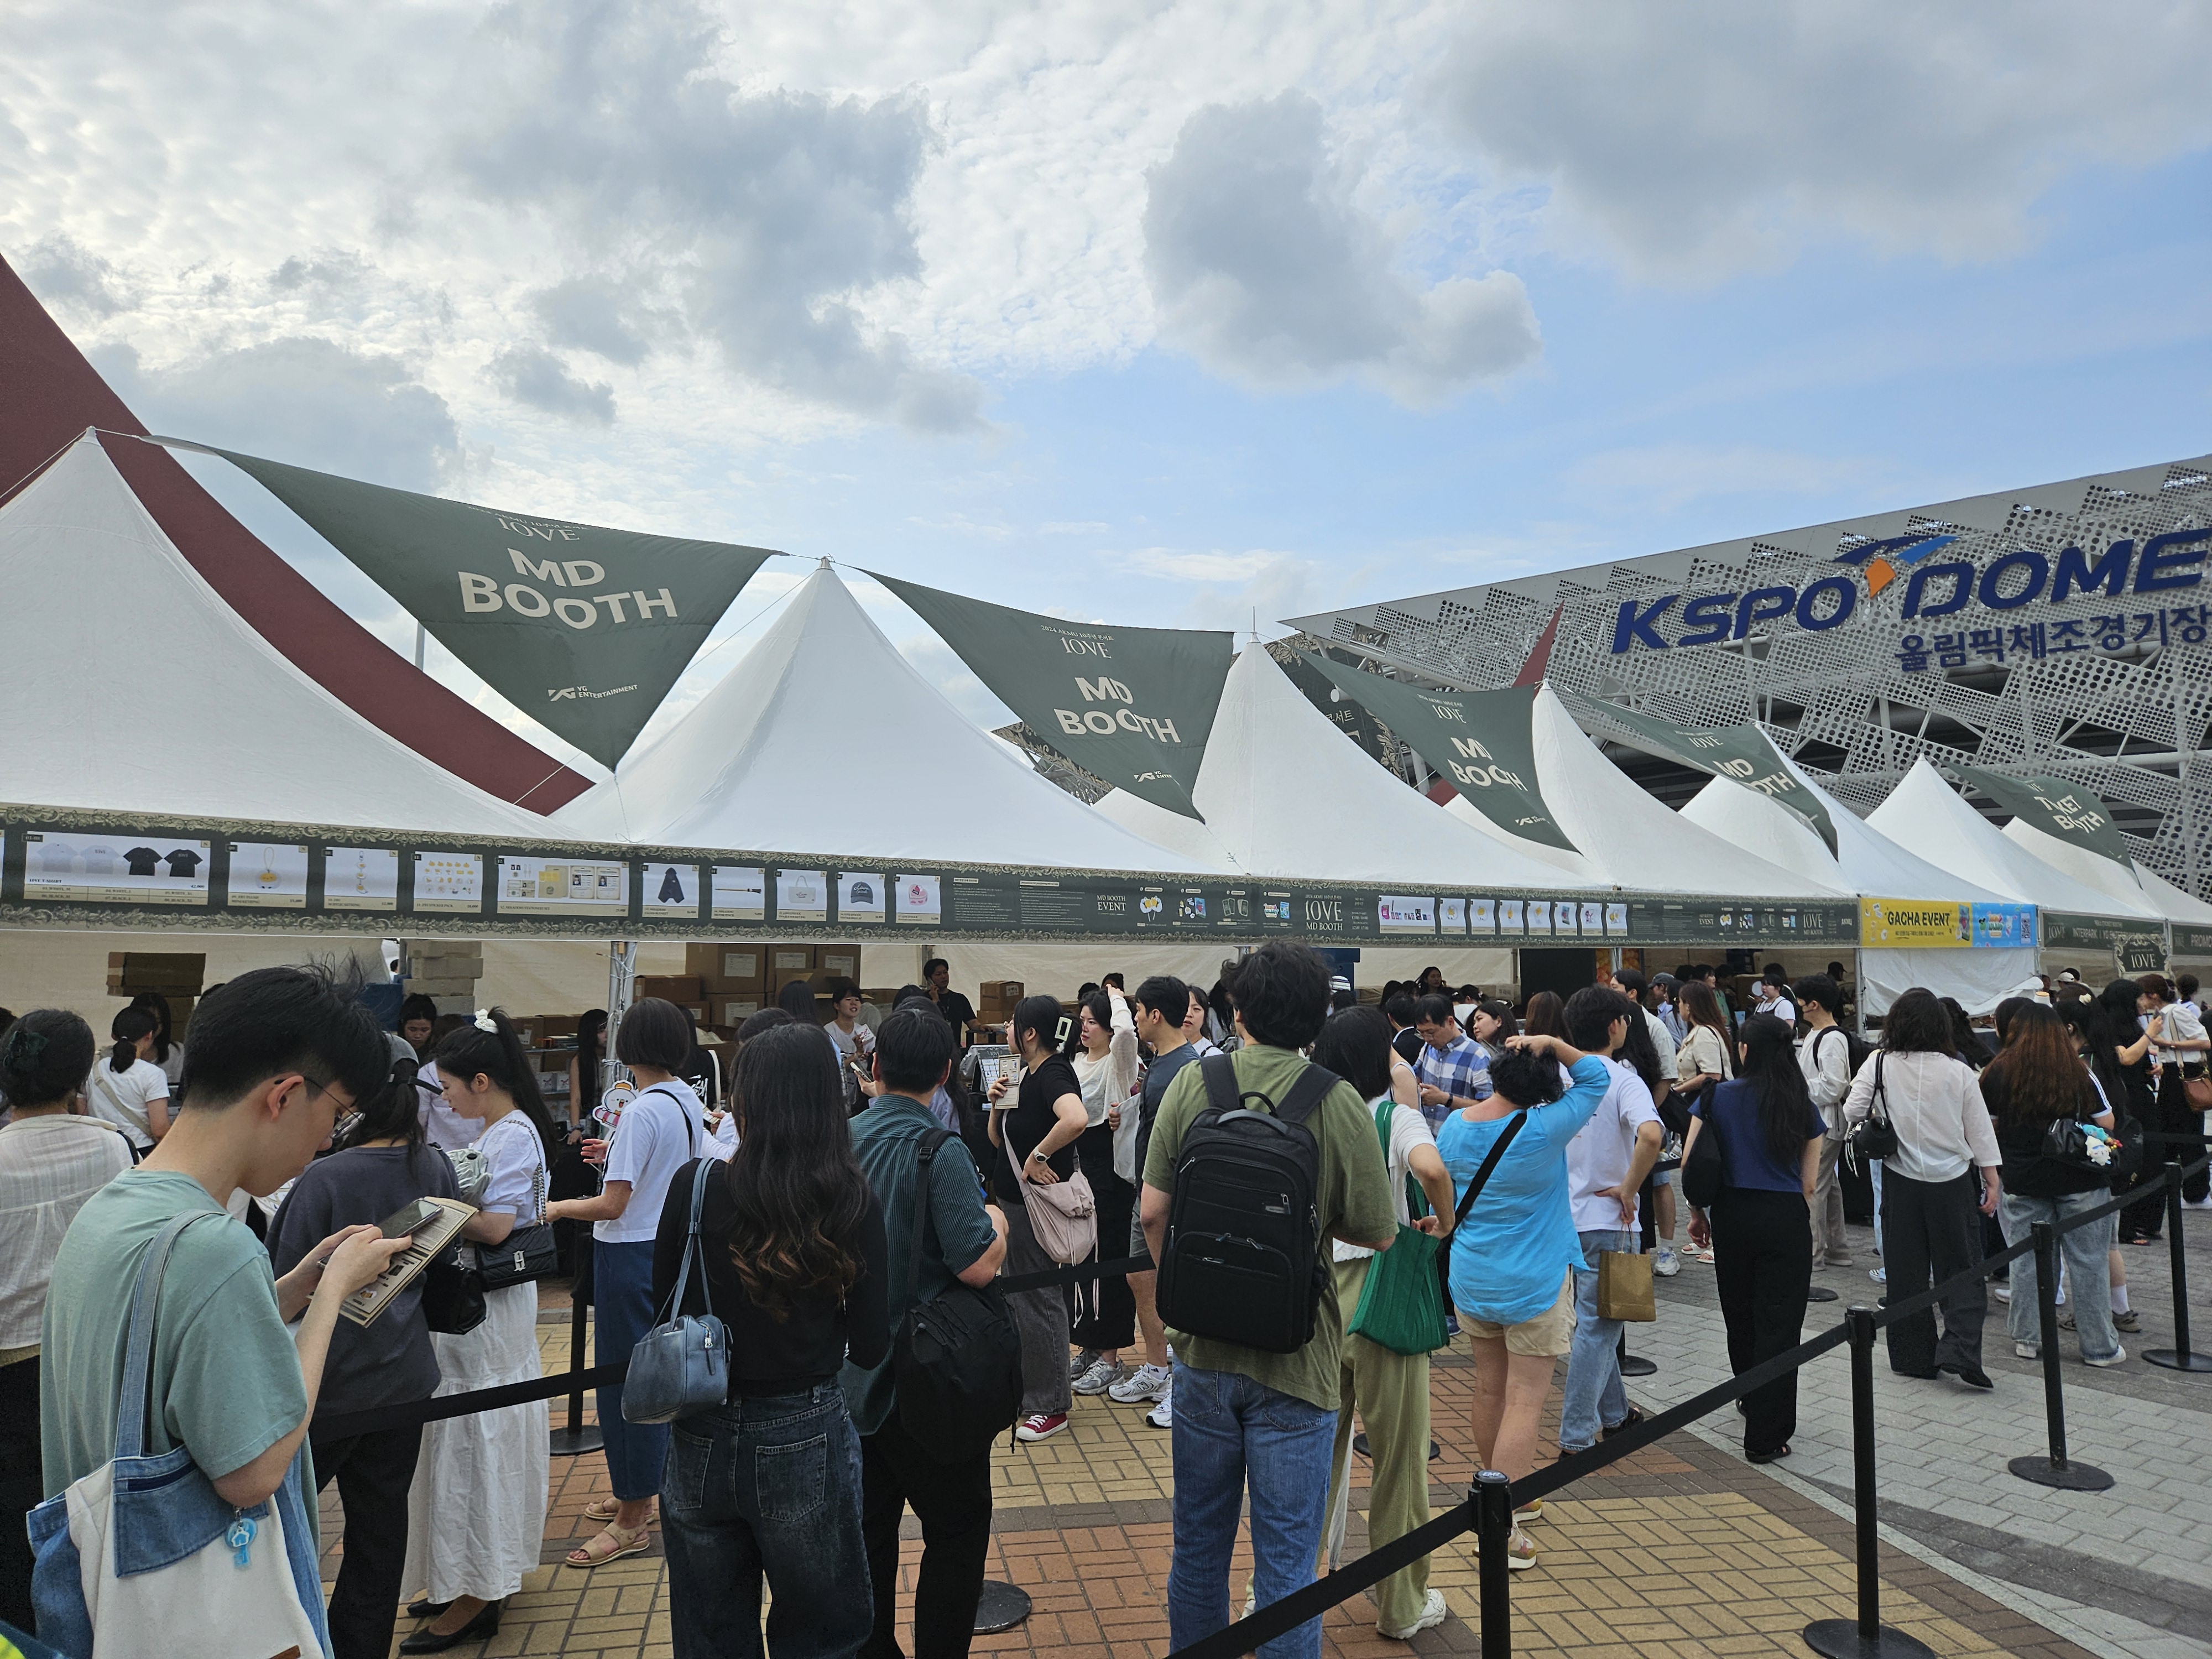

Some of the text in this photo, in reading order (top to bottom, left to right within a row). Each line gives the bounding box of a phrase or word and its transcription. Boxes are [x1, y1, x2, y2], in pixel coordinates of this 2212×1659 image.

[508, 547, 606, 587] MD
[458, 571, 678, 629] BOOTH
[1611, 528, 2212, 654] KSPO DOME
[1058, 629, 1078, 637] AKMU
[1895, 604, 2212, 672] 올림픽체조경기장
[578, 684, 638, 698] ENTERTAINMENT
[1074, 676, 1134, 705] MD
[1053, 708, 1181, 743] BOOTH
[1451, 737, 1493, 761] MD
[1712, 758, 1755, 778] MD
[1097, 902, 1126, 911] EVENT
[1306, 922, 1343, 931] MD BOOTH
[1887, 911, 1950, 926] GACHA EVENT
[2073, 927, 2098, 938] INTERPARK
